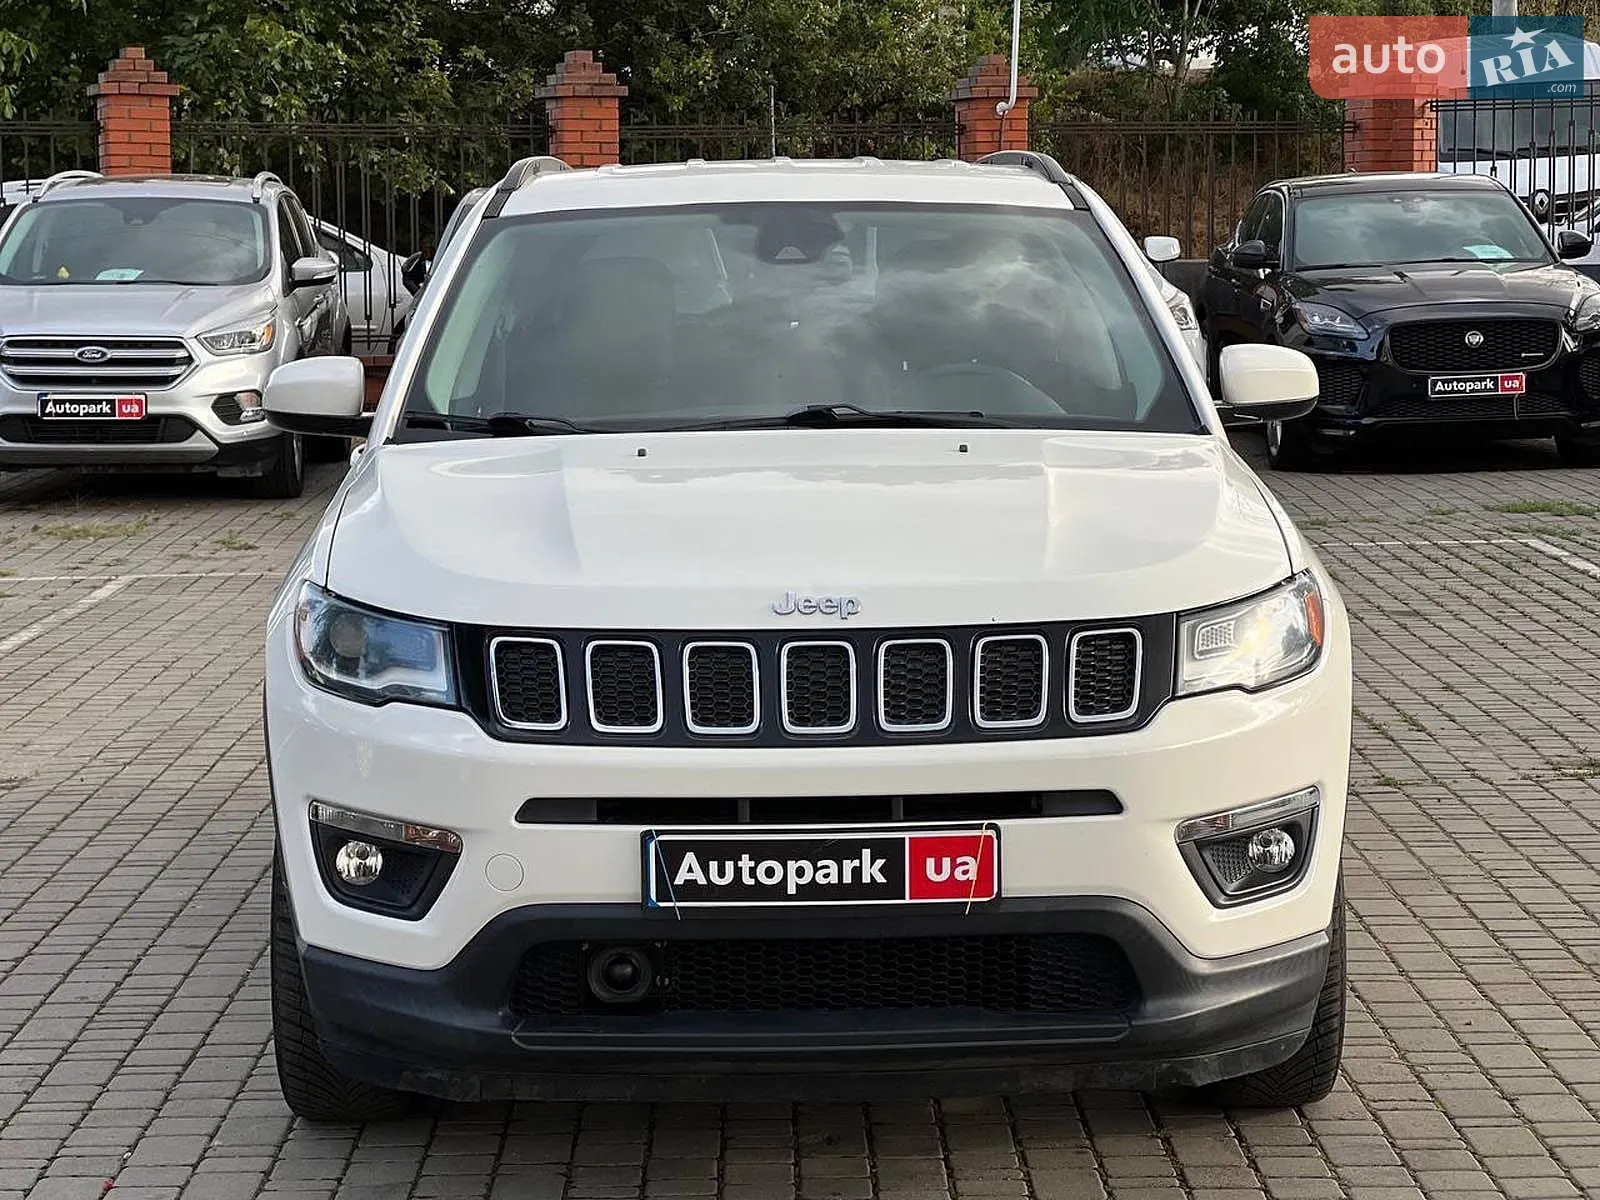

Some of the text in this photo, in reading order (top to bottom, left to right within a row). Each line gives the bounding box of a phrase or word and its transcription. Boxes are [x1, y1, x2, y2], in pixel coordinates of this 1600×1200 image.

[82, 350, 103, 358] Ford
[1434, 378, 1520, 392] Autopark ua
[45, 401, 140, 416] Autopark ua
[772, 591, 862, 620] Jeep
[673, 848, 978, 895] Autopark ua
